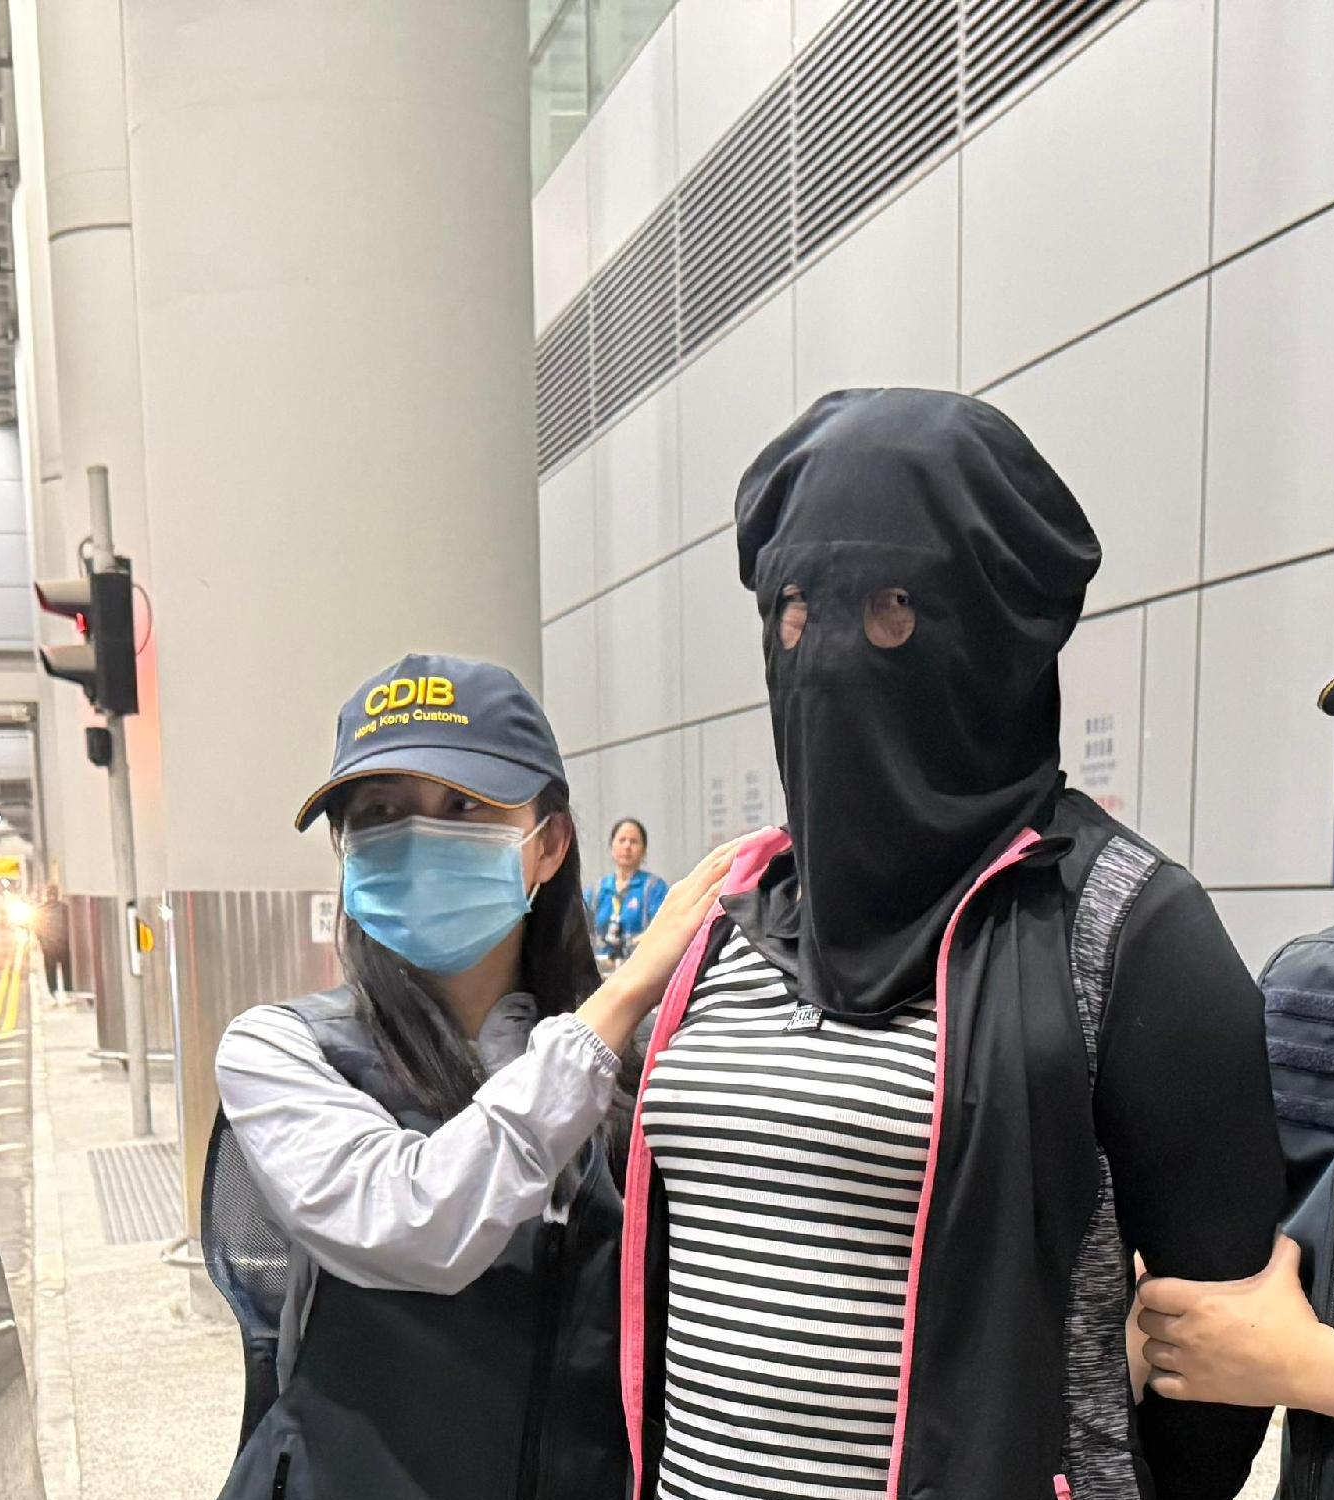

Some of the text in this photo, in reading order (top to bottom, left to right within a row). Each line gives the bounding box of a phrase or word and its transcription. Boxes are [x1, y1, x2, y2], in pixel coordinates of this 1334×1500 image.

[365, 676, 454, 716] CDIB
[379, 712, 409, 727] Kong
[412, 709, 469, 725] Customs
